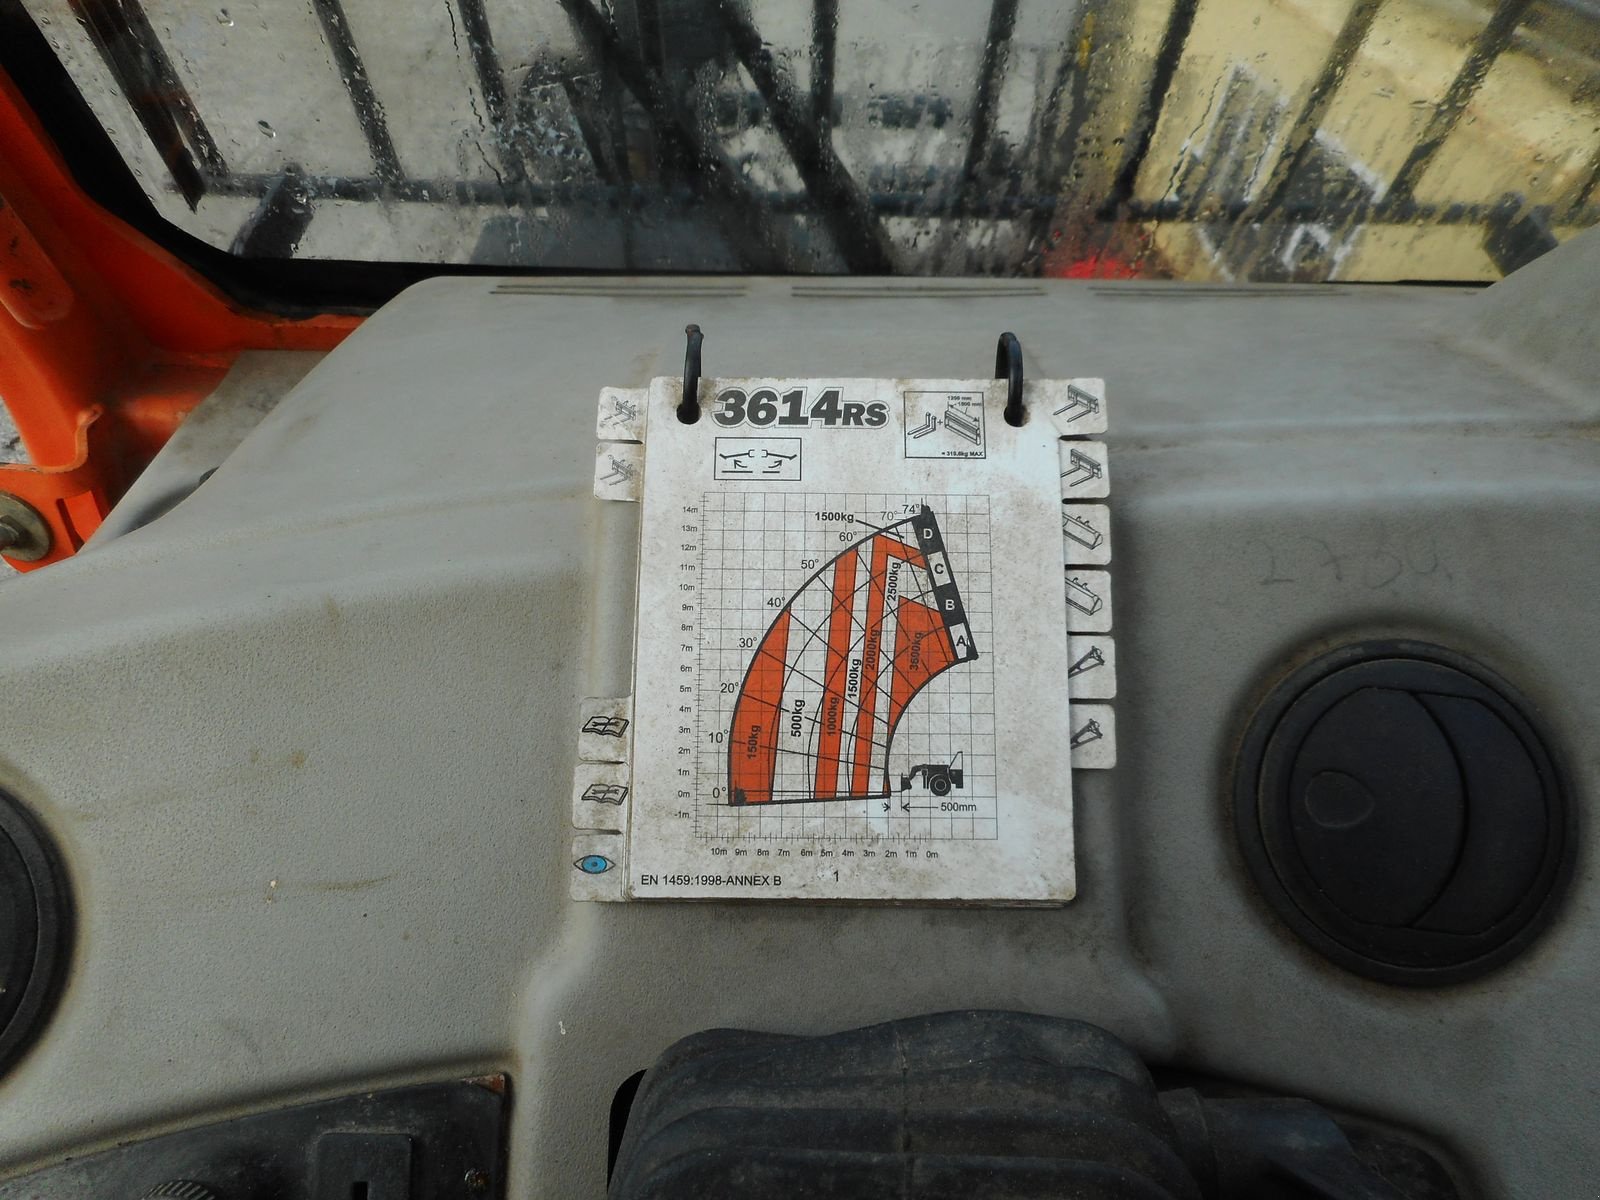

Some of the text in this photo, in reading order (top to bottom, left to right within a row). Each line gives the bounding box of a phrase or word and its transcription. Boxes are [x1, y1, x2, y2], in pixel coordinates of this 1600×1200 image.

[714, 390, 889, 427] 3614RS
[815, 512, 854, 523] 1500kg
[923, 528, 933, 539] D
[934, 563, 944, 575] C
[887, 562, 901, 601] 2500kg
[945, 600, 955, 611] B
[956, 635, 967, 647] A
[680, 644, 693, 652] 7m
[865, 629, 880, 671] 2000kg
[680, 665, 692, 673] 6m
[848, 659, 862, 699] 1500kg
[679, 685, 692, 693] 5m
[679, 705, 692, 713] 4m
[791, 699, 806, 737] 500kg
[827, 696, 840, 736] 1000kg
[678, 726, 691, 734] 3m
[747, 725, 761, 760] 150kg
[678, 747, 691, 755] 2m
[678, 768, 690, 776] 1m
[677, 790, 690, 798] 0m
[940, 802, 977, 812] 500mm
[711, 848, 728, 856] 10m
[735, 848, 748, 856] 9m
[777, 849, 790, 857] 7m
[800, 849, 813, 857] 6m
[820, 849, 833, 857] 5m
[841, 849, 855, 857] 4m
[863, 849, 876, 857] 3m
[885, 850, 898, 858] 2m
[905, 850, 917, 858] 1m
[926, 850, 938, 859] 0m
[641, 875, 782, 886] EN 1459:1998-ANNEX B
[833, 870, 839, 882] 1
